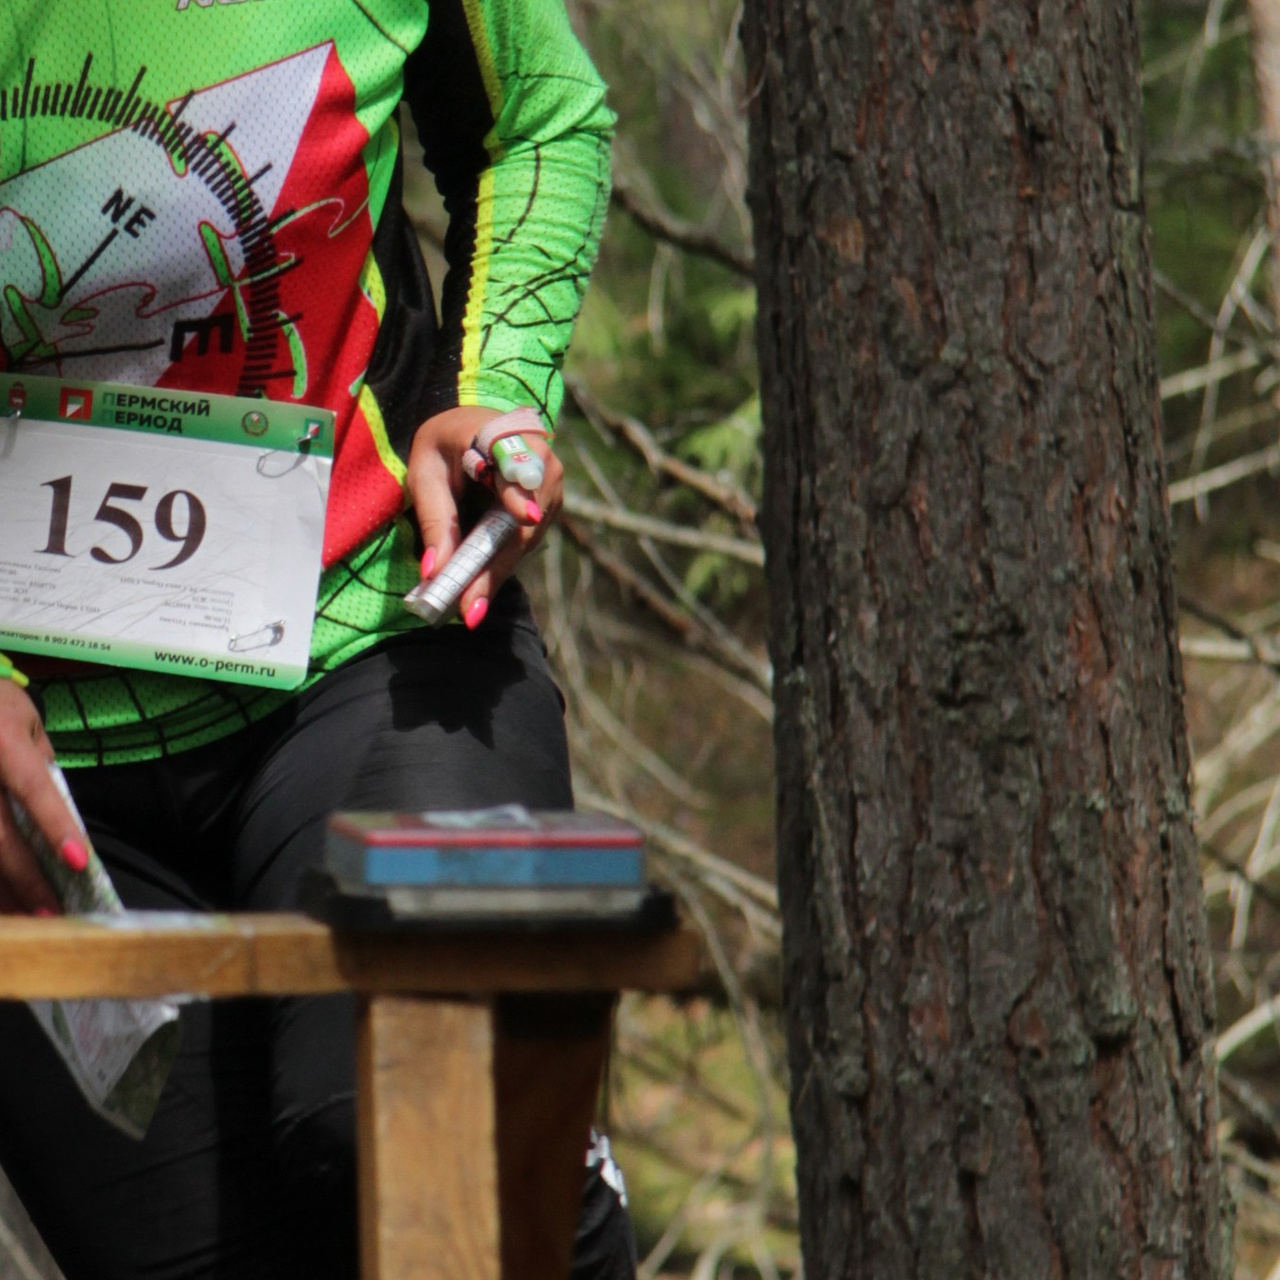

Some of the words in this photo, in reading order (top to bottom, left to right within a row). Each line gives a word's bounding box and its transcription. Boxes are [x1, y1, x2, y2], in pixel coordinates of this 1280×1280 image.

[101, 187, 157, 239] NE
[102, 391, 211, 417] ПЕРМСКИЙ
[102, 409, 183, 434] ПЕРИОД
[33, 474, 207, 571] 159
[154, 650, 276, 678] www.o-perm.ru
